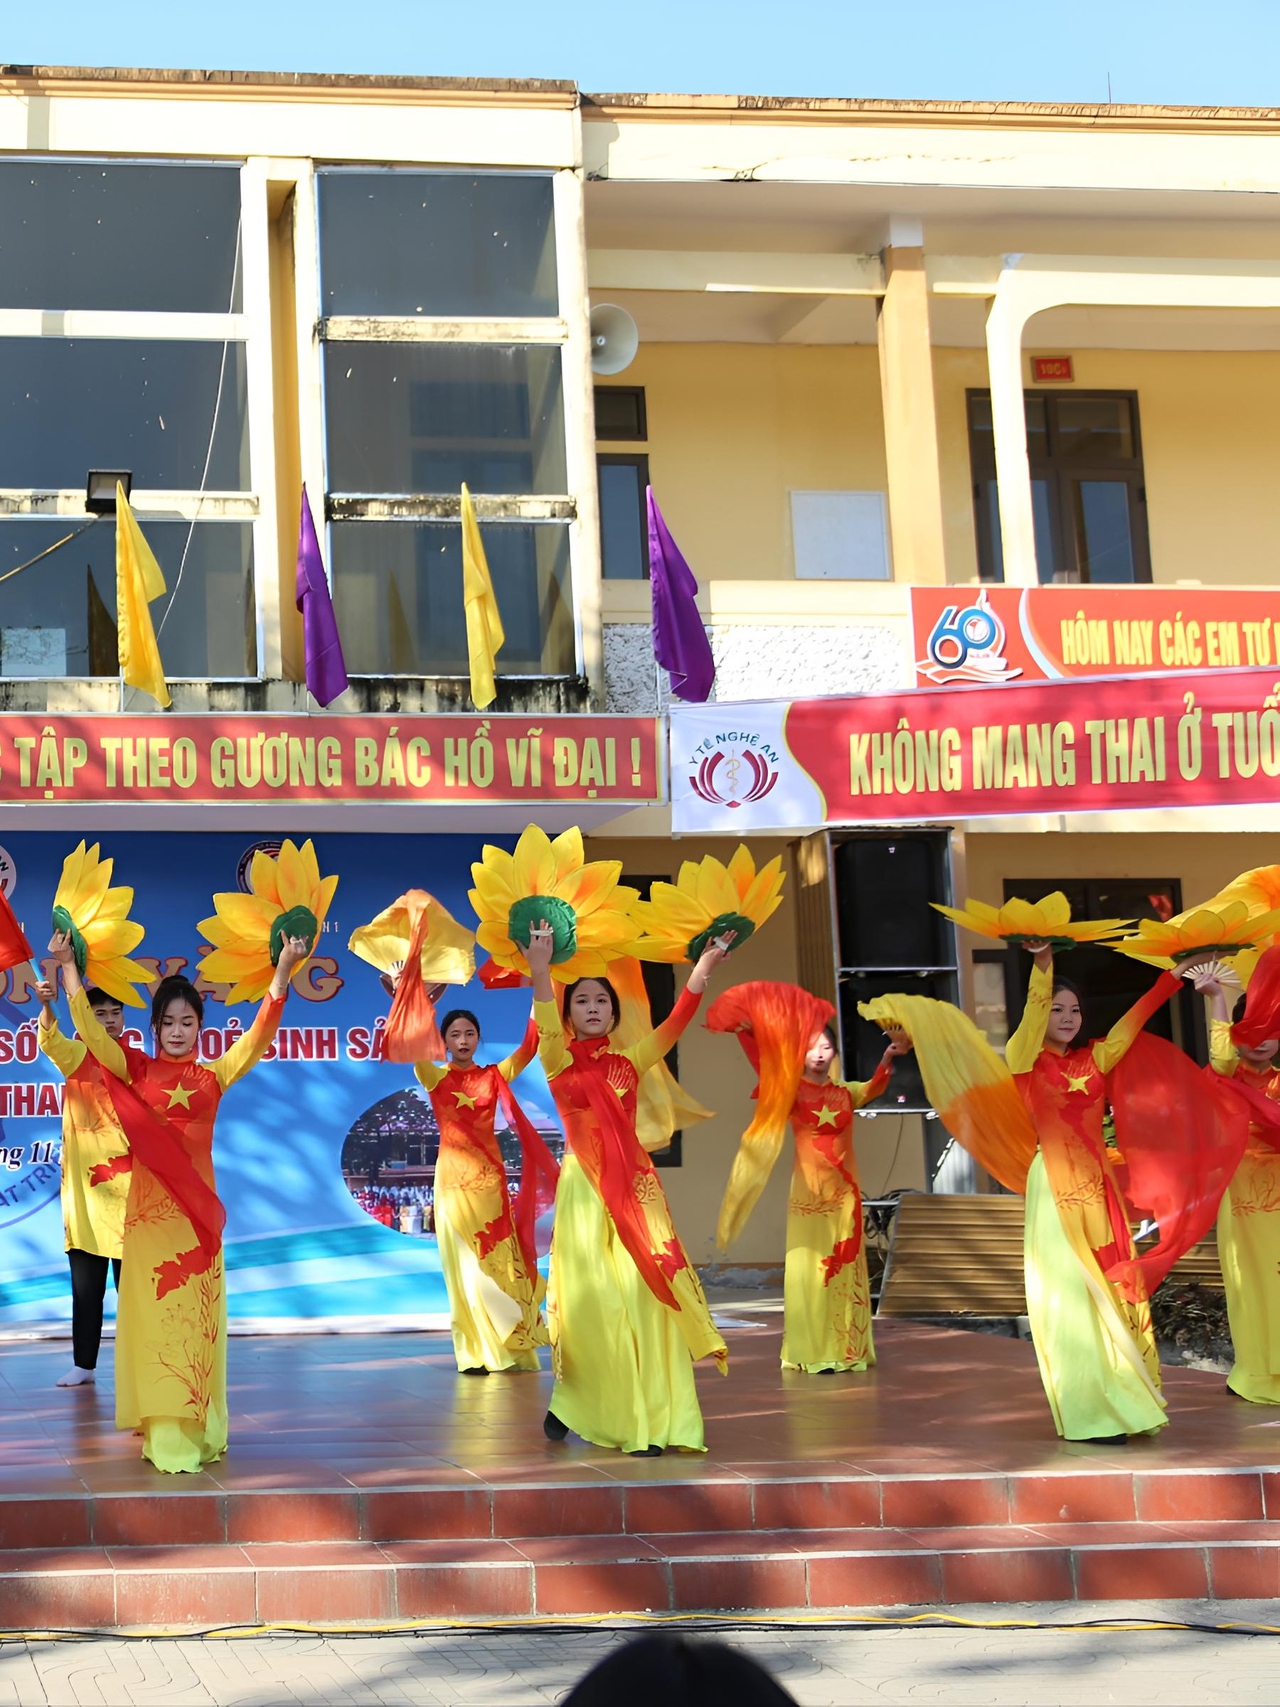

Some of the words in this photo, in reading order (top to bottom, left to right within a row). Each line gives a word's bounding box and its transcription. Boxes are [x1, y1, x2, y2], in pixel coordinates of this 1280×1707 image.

[1060, 610, 1110, 665] HÔM
[1113, 619, 1153, 665] NAY
[1159, 611, 1202, 666] CÁC
[1205, 621, 1240, 666] EM
[14, 725, 88, 799] TẬP
[100, 737, 197, 788] THEO
[210, 731, 342, 788] GƯƠNG
[355, 726, 431, 788] BÁC
[444, 720, 494, 788] HỒ
[506, 727, 543, 787] VĨ
[553, 737, 616, 798] ĐẠI
[630, 737, 641, 787] !
[688, 756, 698, 765] Y
[760, 744, 779, 763] AN
[849, 717, 961, 795] KHÔNG
[972, 721, 1075, 790] MANG
[1085, 716, 1166, 783] THAI
[1177, 691, 1202, 781] Ở
[31, 1141, 52, 1163] 11
